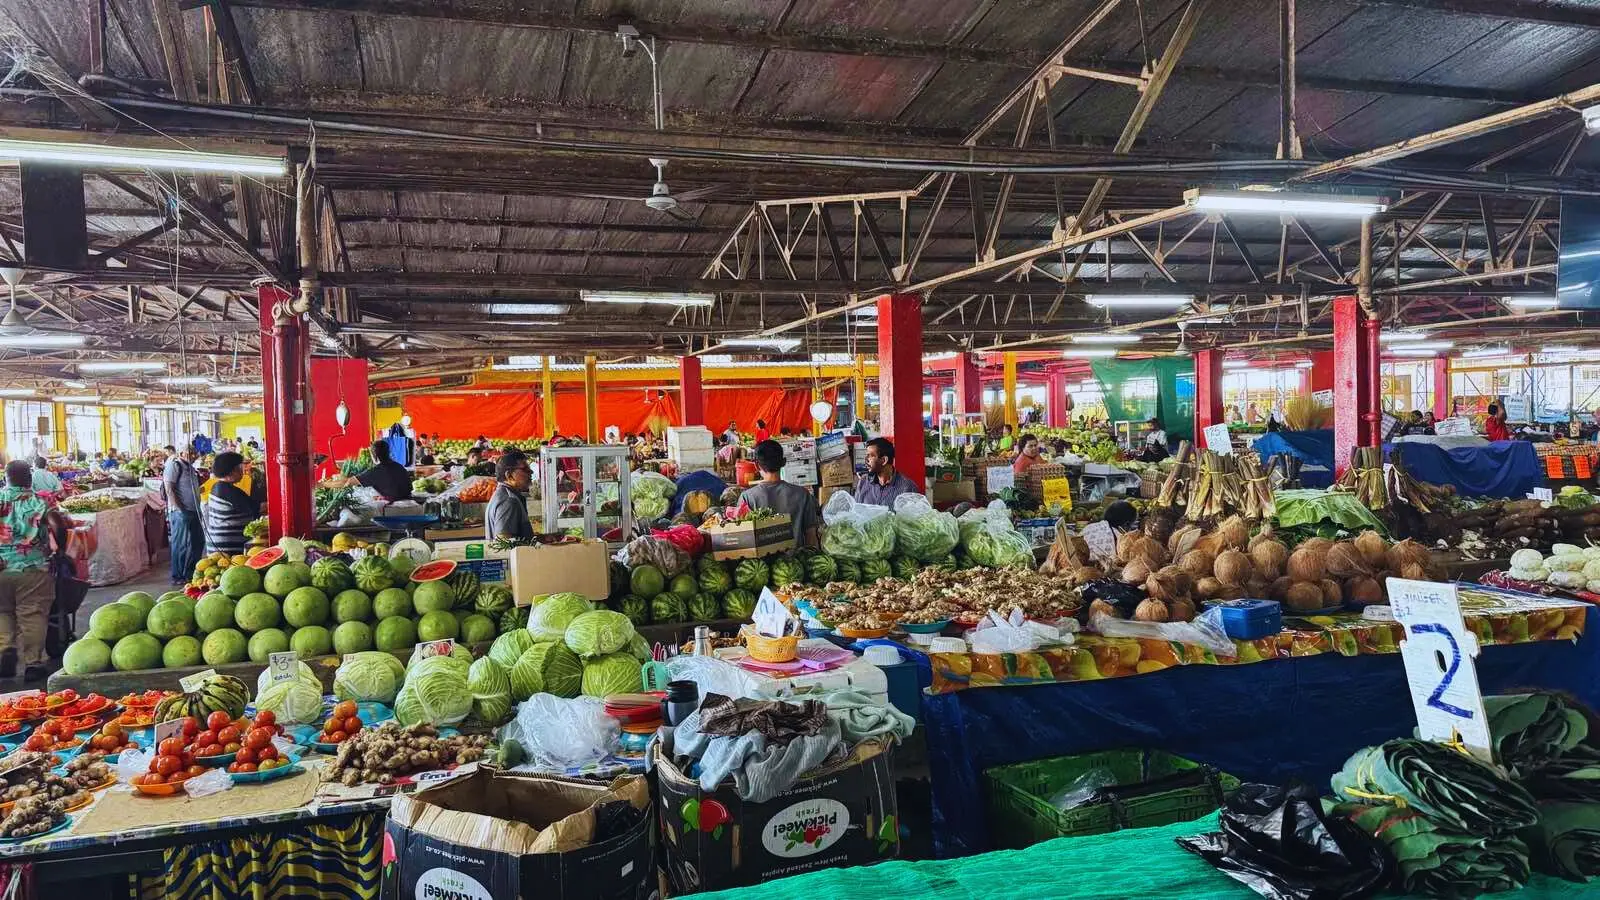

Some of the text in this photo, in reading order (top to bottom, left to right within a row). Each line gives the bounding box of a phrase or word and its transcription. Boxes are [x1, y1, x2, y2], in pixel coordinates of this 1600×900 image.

[1410, 623, 1474, 719] 2
[773, 812, 837, 838] PickMee!
[795, 807, 820, 817] Fresh
